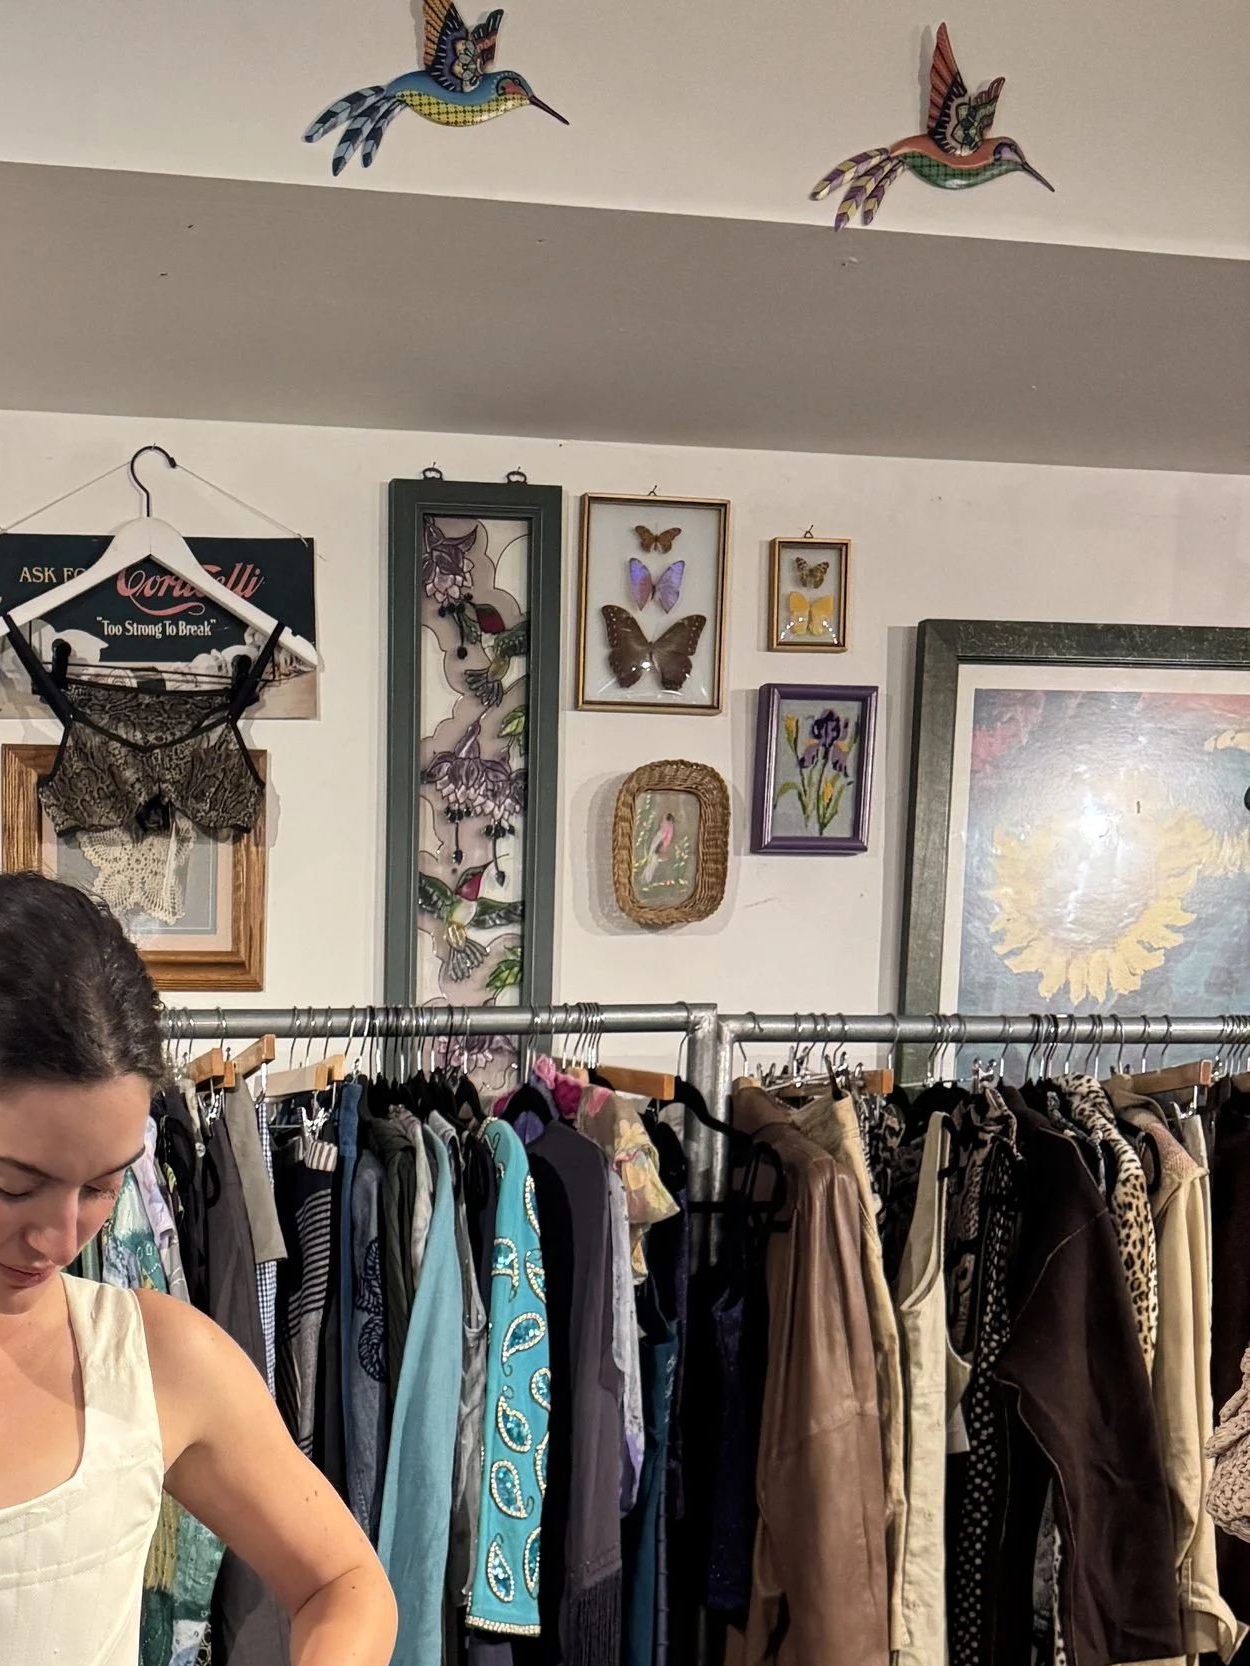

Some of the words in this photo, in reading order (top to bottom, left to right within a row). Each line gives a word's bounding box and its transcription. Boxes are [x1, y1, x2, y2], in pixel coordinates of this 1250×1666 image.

[19, 567, 57, 583] ASK
[125, 620, 162, 639] Strong
[164, 620, 176, 636] To
